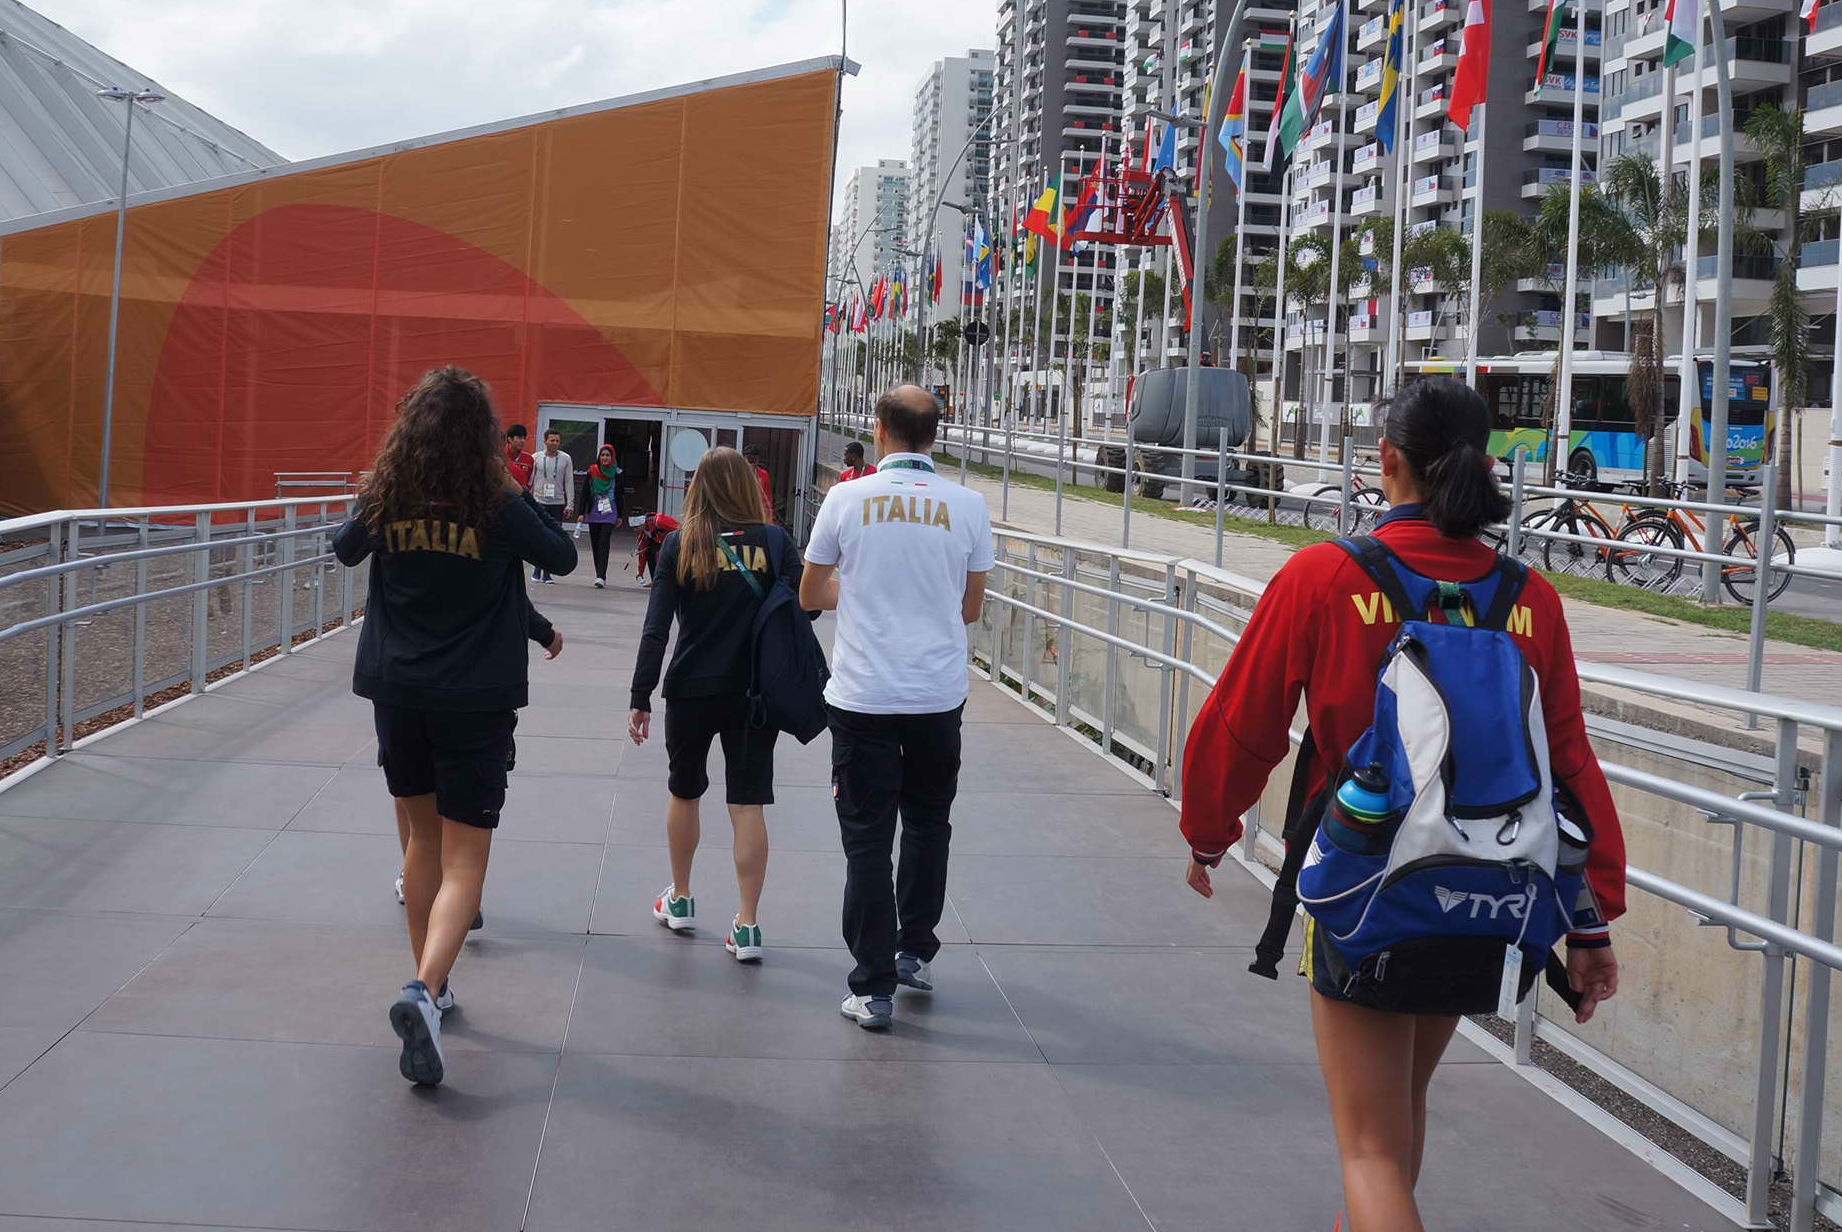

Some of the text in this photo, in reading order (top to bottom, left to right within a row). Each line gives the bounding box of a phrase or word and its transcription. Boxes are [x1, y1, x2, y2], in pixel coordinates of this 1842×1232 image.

[862, 495, 952, 532] ITALIA
[384, 519, 481, 560] ITALIA
[1469, 893, 1526, 918] TYR
